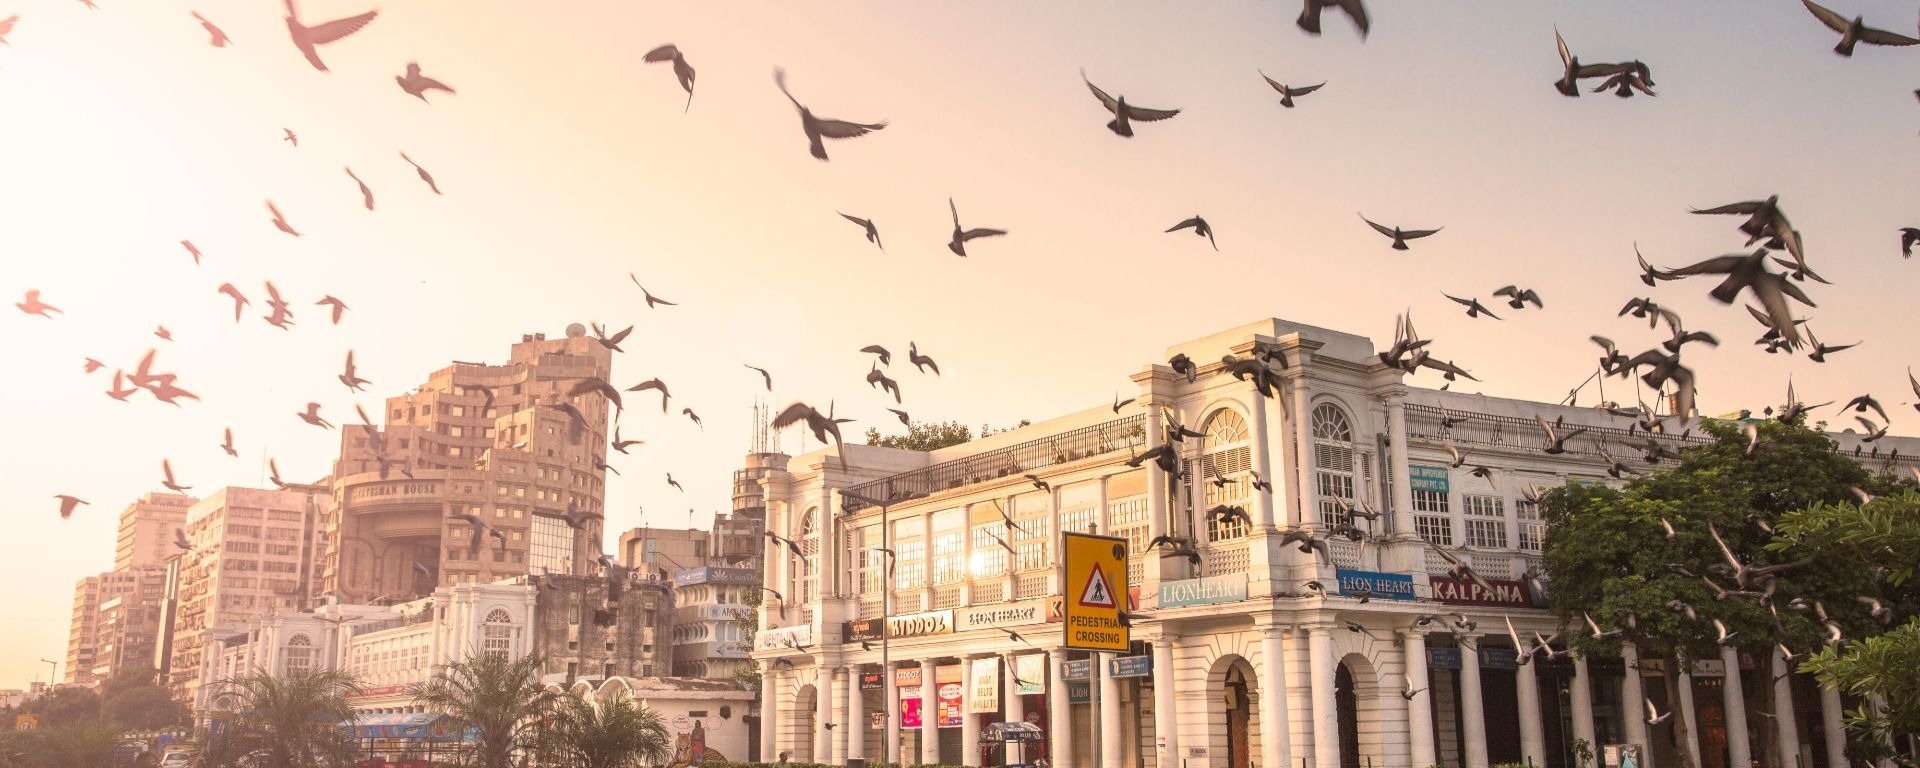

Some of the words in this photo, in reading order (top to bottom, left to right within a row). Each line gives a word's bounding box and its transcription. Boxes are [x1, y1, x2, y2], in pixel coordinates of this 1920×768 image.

[353, 485, 398, 499] STATESMAN
[403, 483, 437, 495] HOUSE
[1163, 580, 1240, 603] LIONHEART
[1344, 576, 1372, 592] LION
[1376, 579, 1413, 594] HEART
[1432, 581, 1524, 603] KALPANA
[969, 611, 997, 626] LION
[999, 607, 1036, 622] HEART
[1070, 615, 1125, 630] PEDESTRIAN
[1075, 630, 1120, 645] CROSSING
